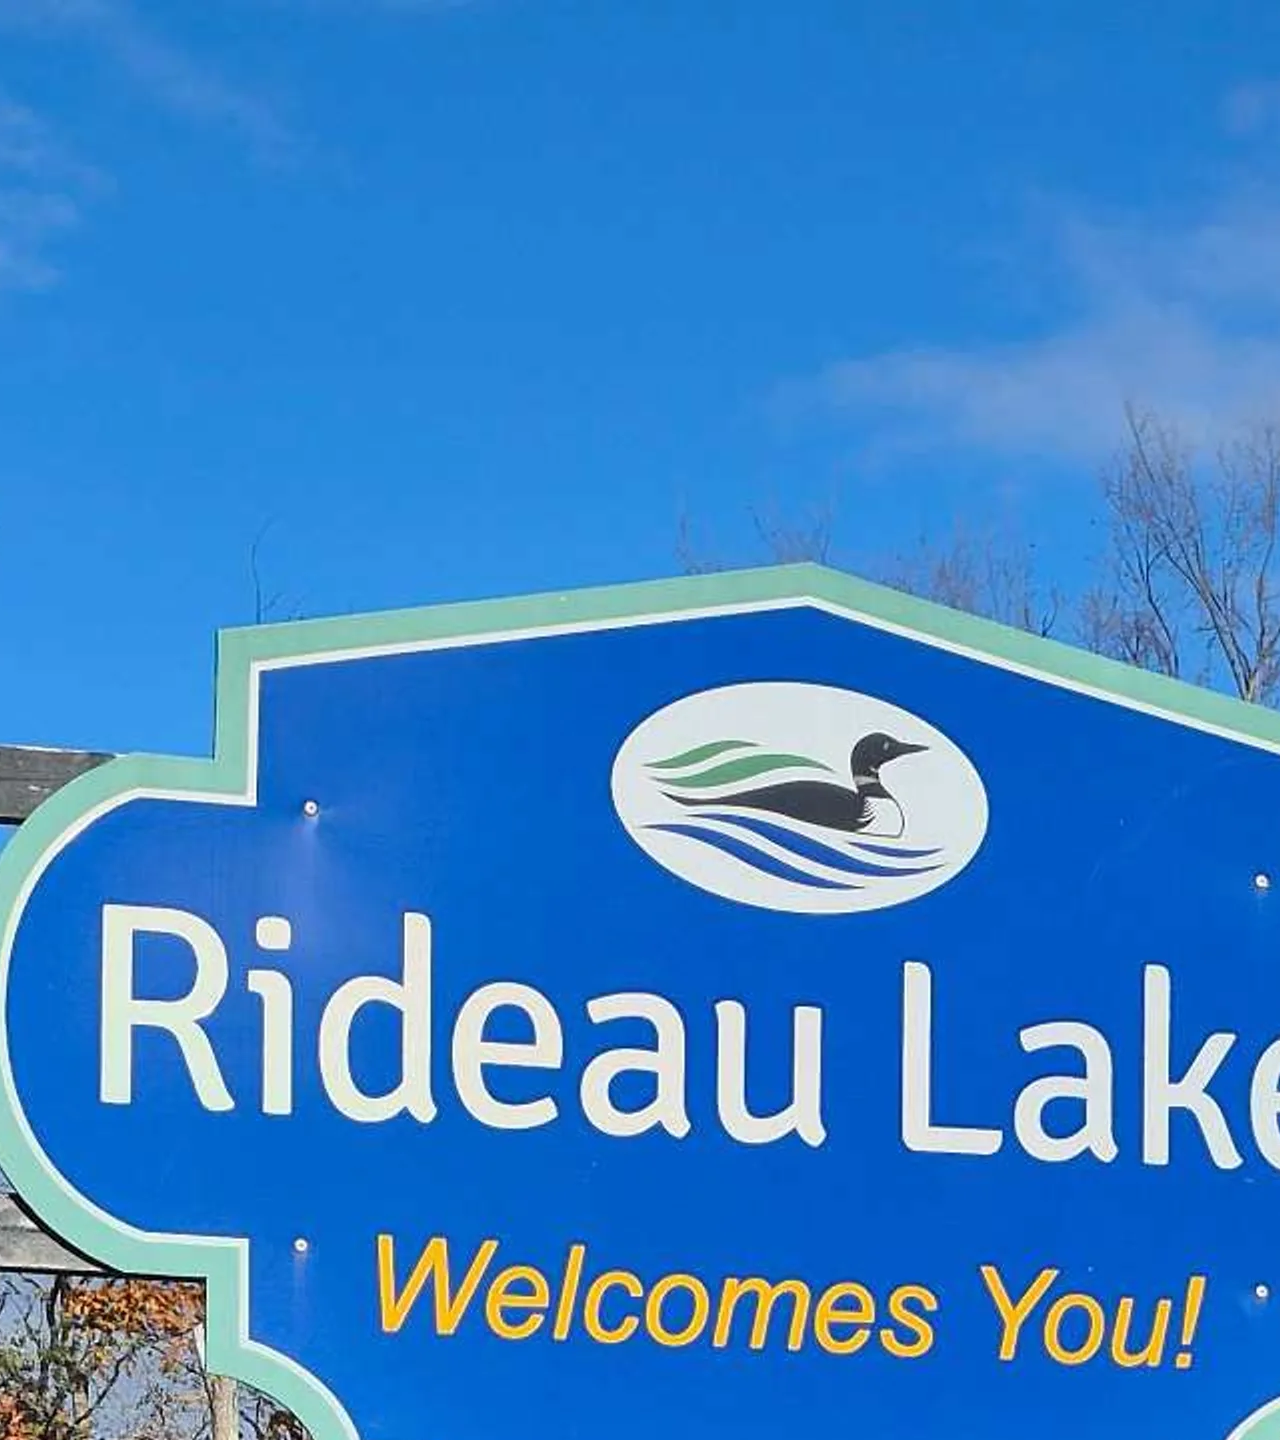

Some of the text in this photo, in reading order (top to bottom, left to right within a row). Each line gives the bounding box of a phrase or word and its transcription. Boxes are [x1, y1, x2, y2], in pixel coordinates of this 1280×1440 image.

[99, 903, 828, 1148] Rideau
[376, 1233, 1207, 1369] Welcomes You!
